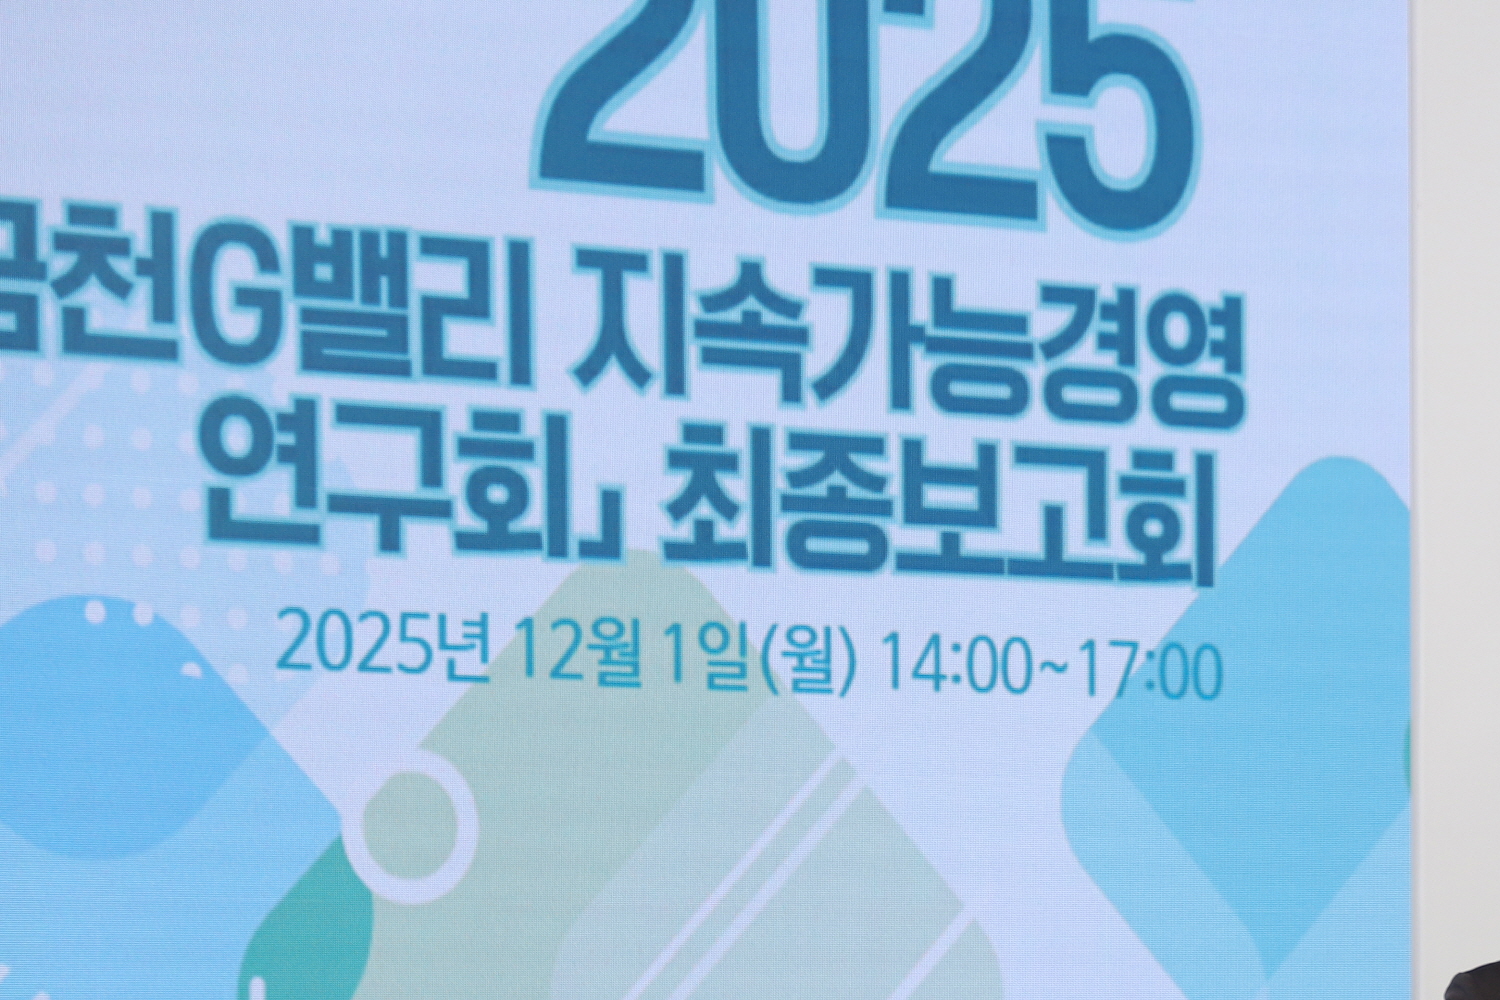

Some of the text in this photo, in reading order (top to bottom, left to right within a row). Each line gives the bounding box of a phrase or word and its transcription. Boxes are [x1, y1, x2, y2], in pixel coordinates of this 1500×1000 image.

[530, 0, 1204, 242] 2025
[568, 241, 1248, 432] 지속가능경영
[656, 418, 1219, 591] 최종보고회
[275, 606, 1225, 701] 2025년 12월 1일(월) 14:00~17:00
